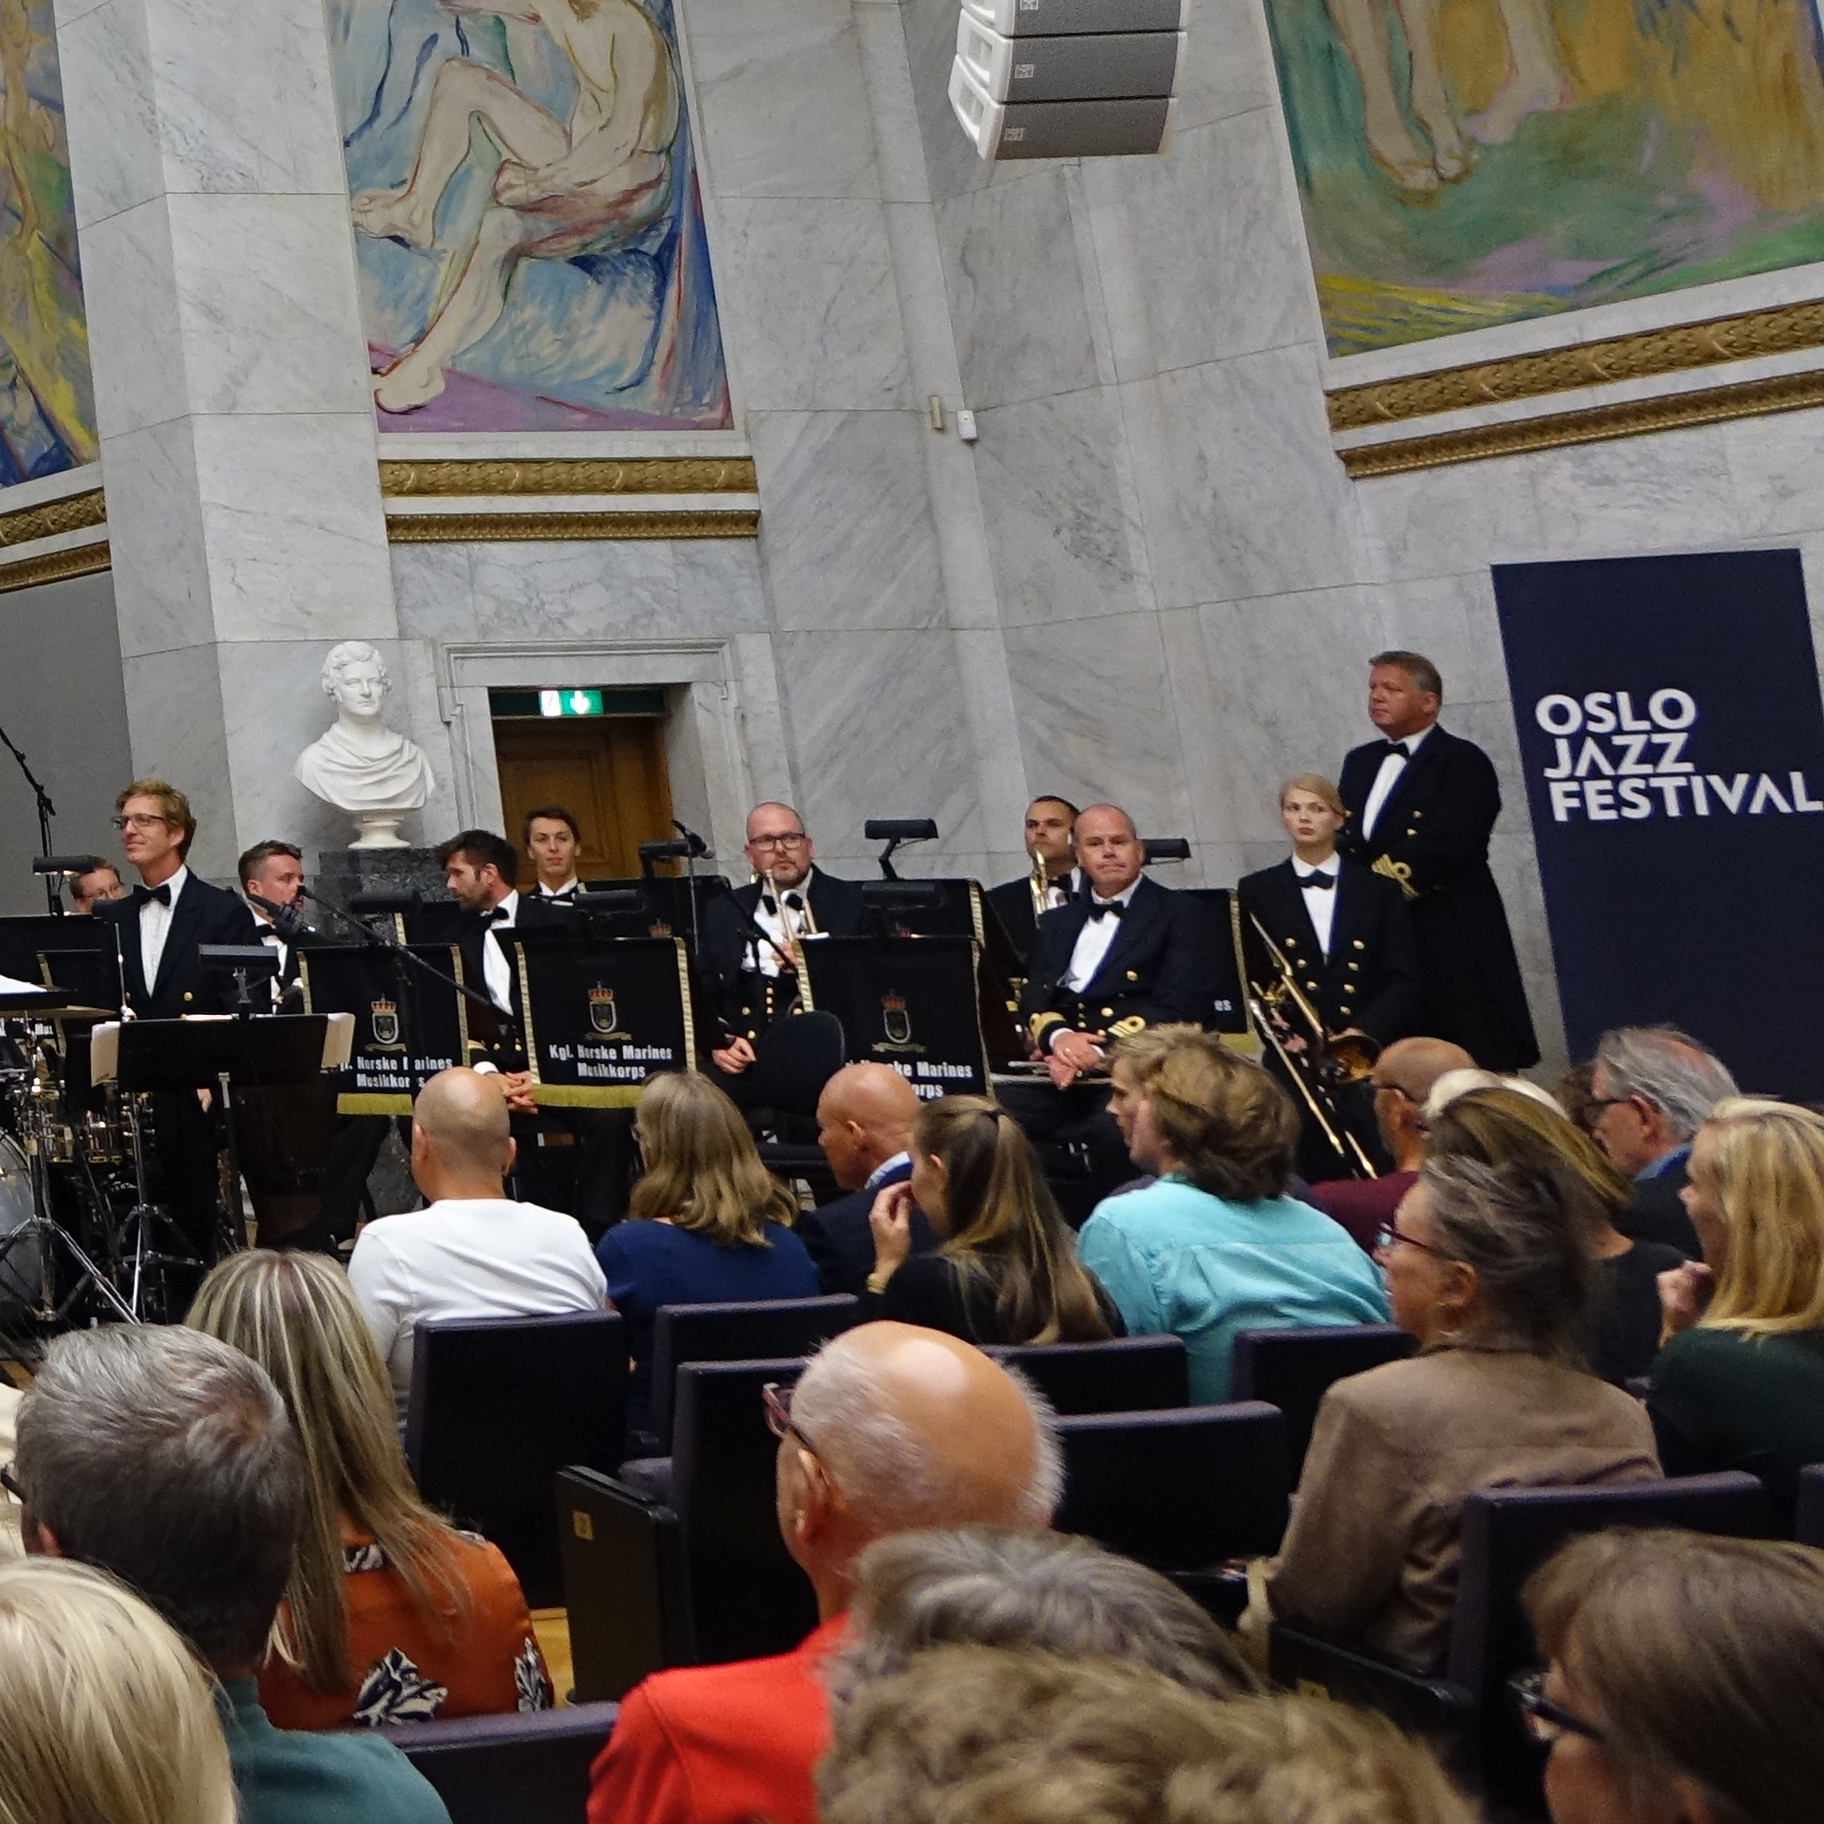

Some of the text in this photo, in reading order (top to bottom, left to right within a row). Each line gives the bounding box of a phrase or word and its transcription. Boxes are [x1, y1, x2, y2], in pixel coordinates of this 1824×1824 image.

[1535, 688, 1696, 735] OSLO
[1543, 732, 1695, 778] JAZZ
[1549, 771, 1824, 822] FESTIVAL
[549, 1044, 574, 1061] Kgl.
[622, 1045, 672, 1060] Marines
[357, 1056, 397, 1070] Norske
[577, 1062, 646, 1080] Musikkorps
[916, 1061, 973, 1078] Marines
[357, 1074, 426, 1088] Musikkors
